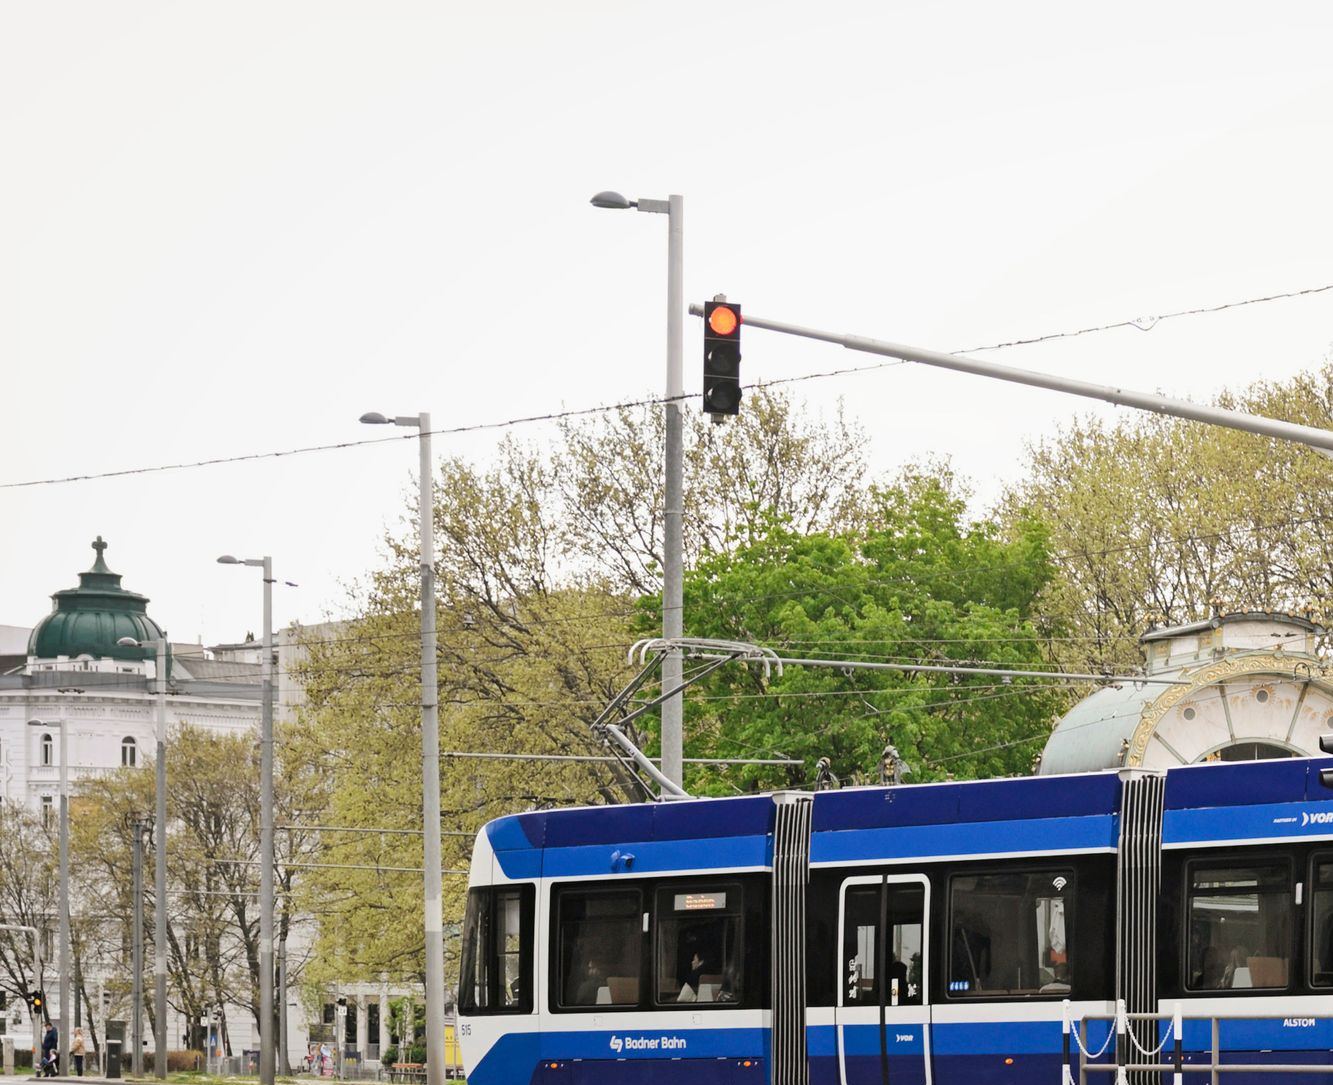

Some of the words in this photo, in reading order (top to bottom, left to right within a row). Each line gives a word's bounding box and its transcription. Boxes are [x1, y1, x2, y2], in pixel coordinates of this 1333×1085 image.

[1310, 812, 1333, 823] VOR
[1283, 1018, 1316, 1027] ALSTOM
[461, 1025, 472, 1036] 515
[625, 1037, 659, 1050] Badner
[662, 1036, 686, 1049] Bahn
